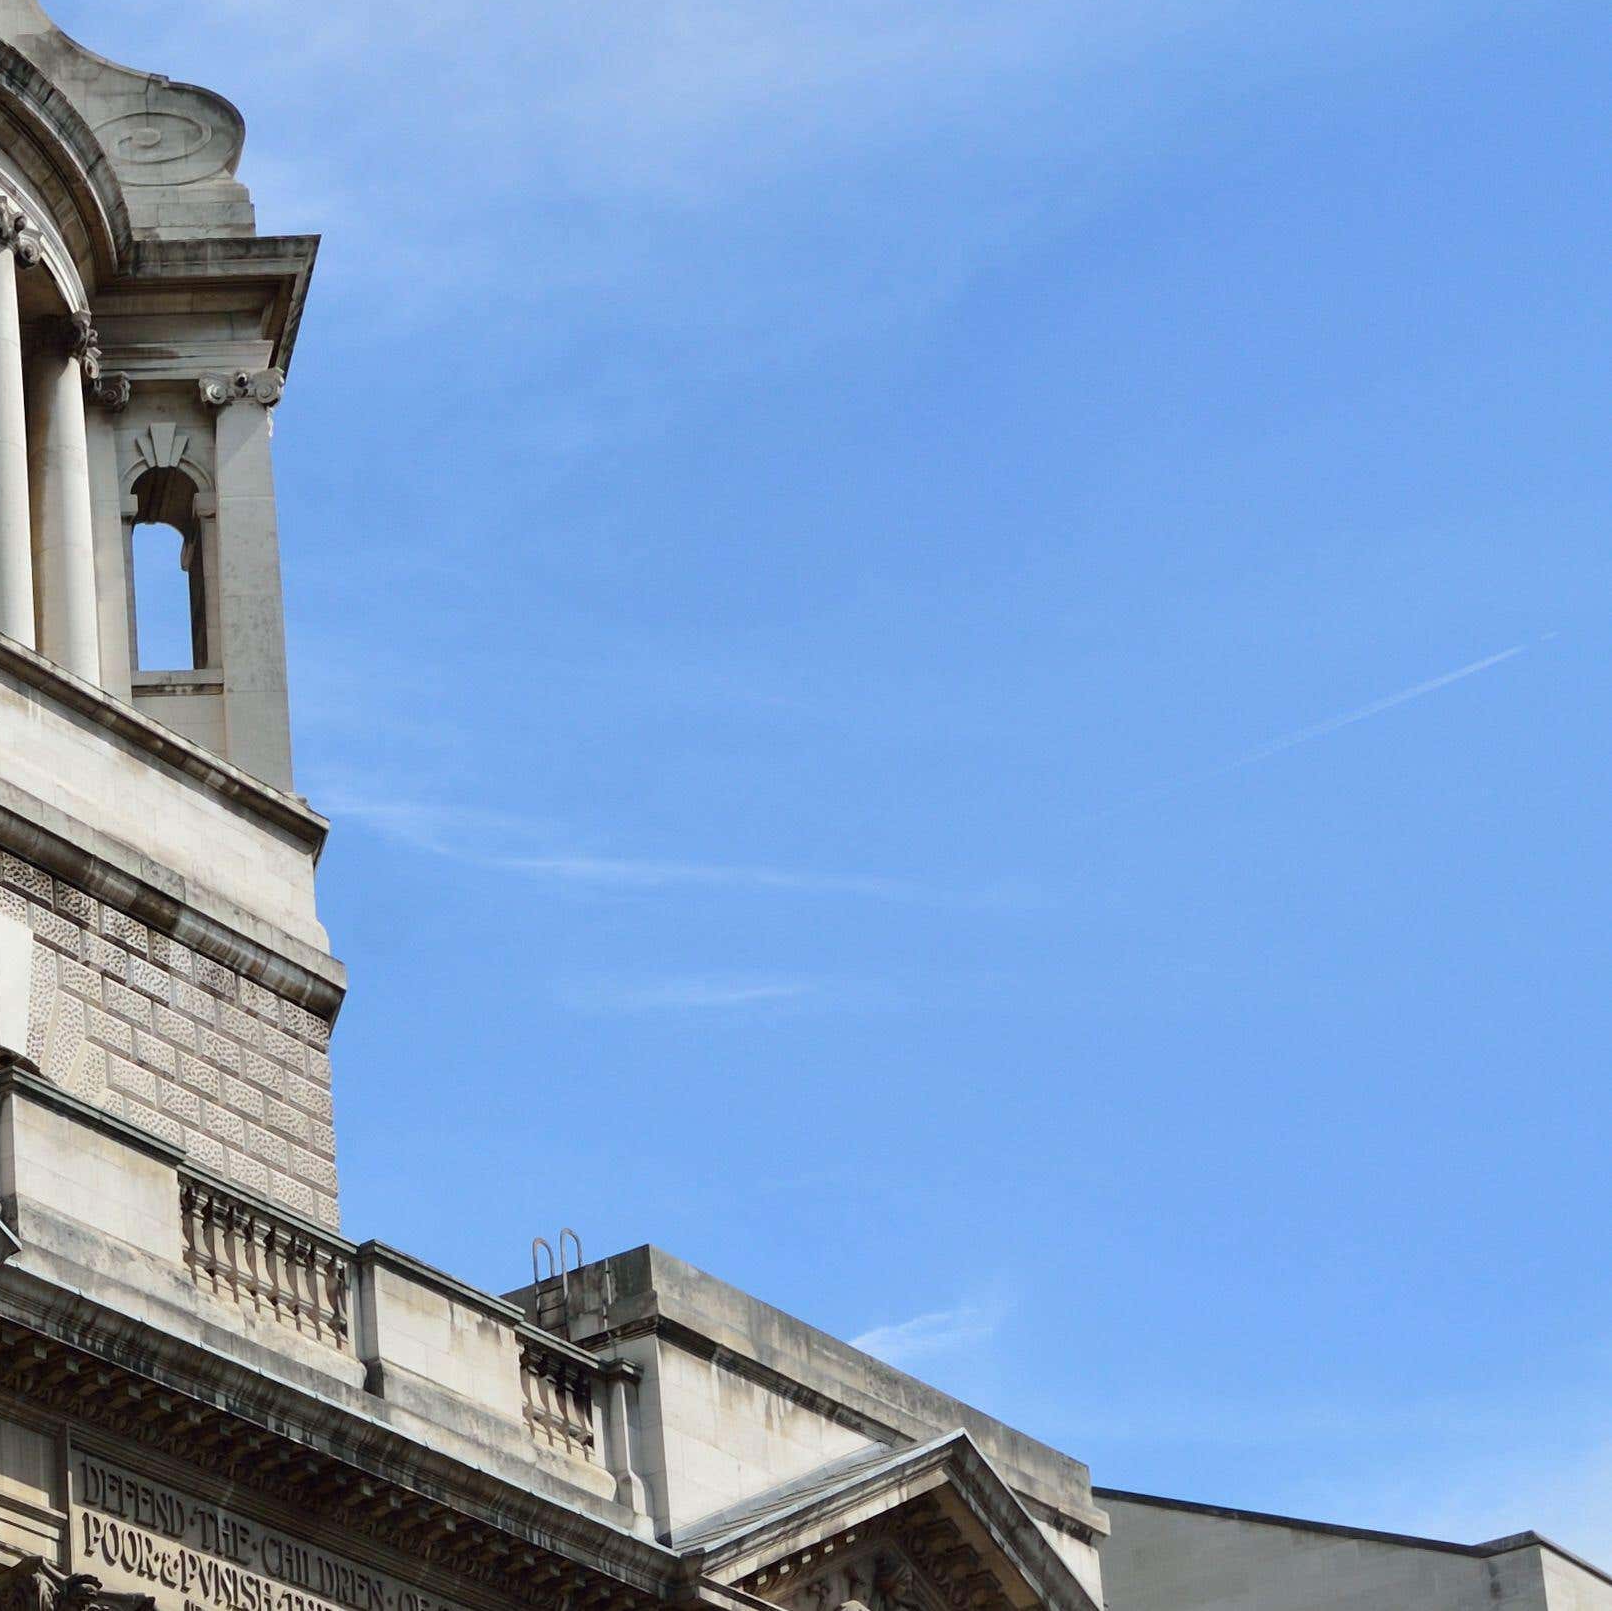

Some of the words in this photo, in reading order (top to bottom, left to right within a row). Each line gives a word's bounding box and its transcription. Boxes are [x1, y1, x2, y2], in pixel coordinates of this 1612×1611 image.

[81, 1460, 184, 1538] DEFEND
[194, 1505, 252, 1566] THE
[261, 1534, 386, 1611] CHILDREN
[81, 1511, 158, 1581] POOR
